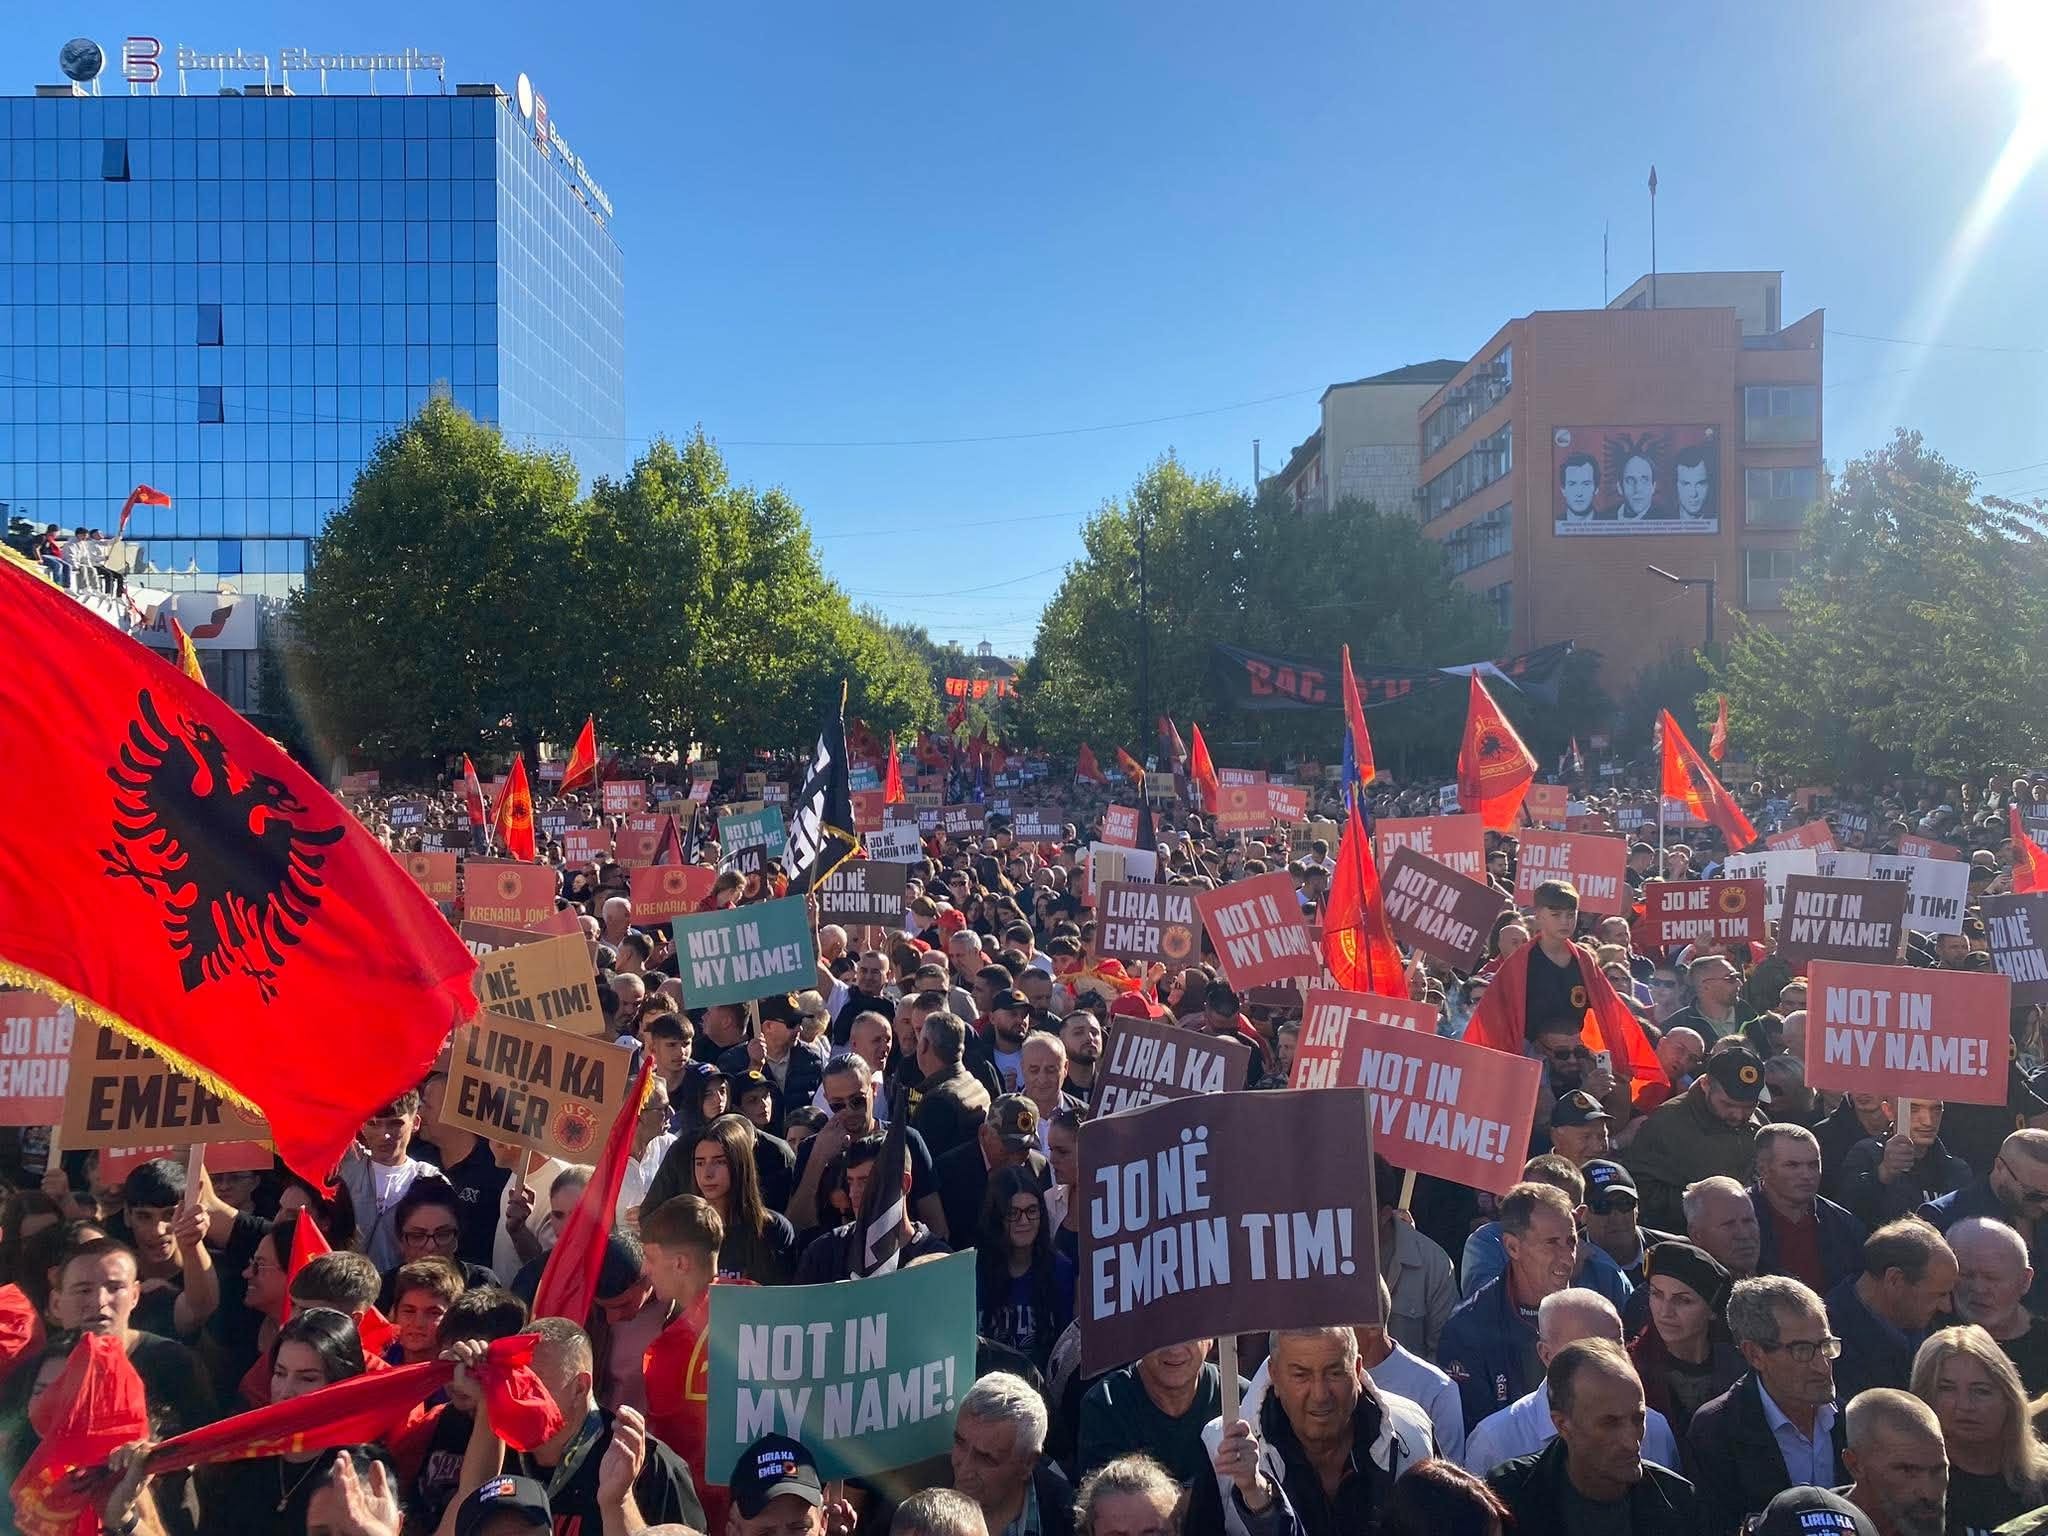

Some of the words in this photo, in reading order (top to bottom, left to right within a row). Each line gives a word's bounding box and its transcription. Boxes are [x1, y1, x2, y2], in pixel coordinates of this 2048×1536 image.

[177, 45, 268, 70] Banka
[279, 46, 447, 70] Ekonomike
[1521, 843, 1546, 867] JO
[1549, 842, 1571, 870] NË
[846, 867, 866, 892] NË
[1394, 865, 1438, 902] NOT
[1434, 885, 1461, 914] IN
[1577, 873, 1616, 899] TIM!
[1661, 891, 1685, 911] JO
[1688, 886, 1711, 909] NË
[469, 906, 521, 923] KRENARIA
[636, 899, 687, 916] KRENARIA
[822, 891, 871, 914] EMRIN
[872, 894, 902, 916] TIM!
[1107, 890, 1160, 921] LIRIA
[1165, 895, 1193, 924] KA
[1214, 899, 1261, 938] NOT
[1259, 894, 1282, 925] IN
[1384, 889, 1420, 922] MY
[1414, 905, 1479, 953] NAME!
[1794, 891, 1839, 918] NOT
[1839, 893, 1863, 919] IN
[1919, 895, 1959, 920] TIM!
[688, 927, 732, 960] NOT
[736, 921, 761, 951] IN
[1104, 920, 1160, 954] EMËR
[1718, 917, 1749, 938] TIM
[1790, 918, 1828, 944] MY
[1828, 920, 1892, 948] NAME!
[2006, 908, 2034, 947] NË
[692, 958, 727, 989] MY
[733, 942, 803, 984] NAME!
[1226, 932, 1264, 969] MY
[486, 961, 520, 1001] NË
[537, 983, 593, 1021] TIM!
[1825, 986, 1892, 1027] NOT
[1899, 991, 1932, 1031] IN
[1, 1016, 30, 1054] JO
[1824, 1027, 1878, 1067] MY
[1885, 1032, 1989, 1077] NAME!
[466, 1025, 553, 1089] LIRIA
[559, 1052, 605, 1104] KA
[1110, 1032, 1176, 1086] LIRIA
[1181, 1047, 1226, 1092] KA
[1357, 1047, 1422, 1096] NOT
[1426, 1061, 1462, 1106] IN
[457, 1075, 550, 1140] EMËR
[1404, 1101, 1511, 1164] NAME!
[1091, 1158, 1150, 1240] JO
[1156, 1125, 1212, 1220] NË
[1091, 1216, 1232, 1321] EMRIN
[1240, 1207, 1357, 1281] TIM!
[737, 1322, 833, 1381] NOT
[844, 1312, 888, 1375] IN
[735, 1387, 813, 1444] MY
[823, 1355, 955, 1441] NAME!
[757, 1451, 780, 1465] LIRIA
[758, 1463, 783, 1479] EMËR
[1801, 1514, 1834, 1528] LIRIA
